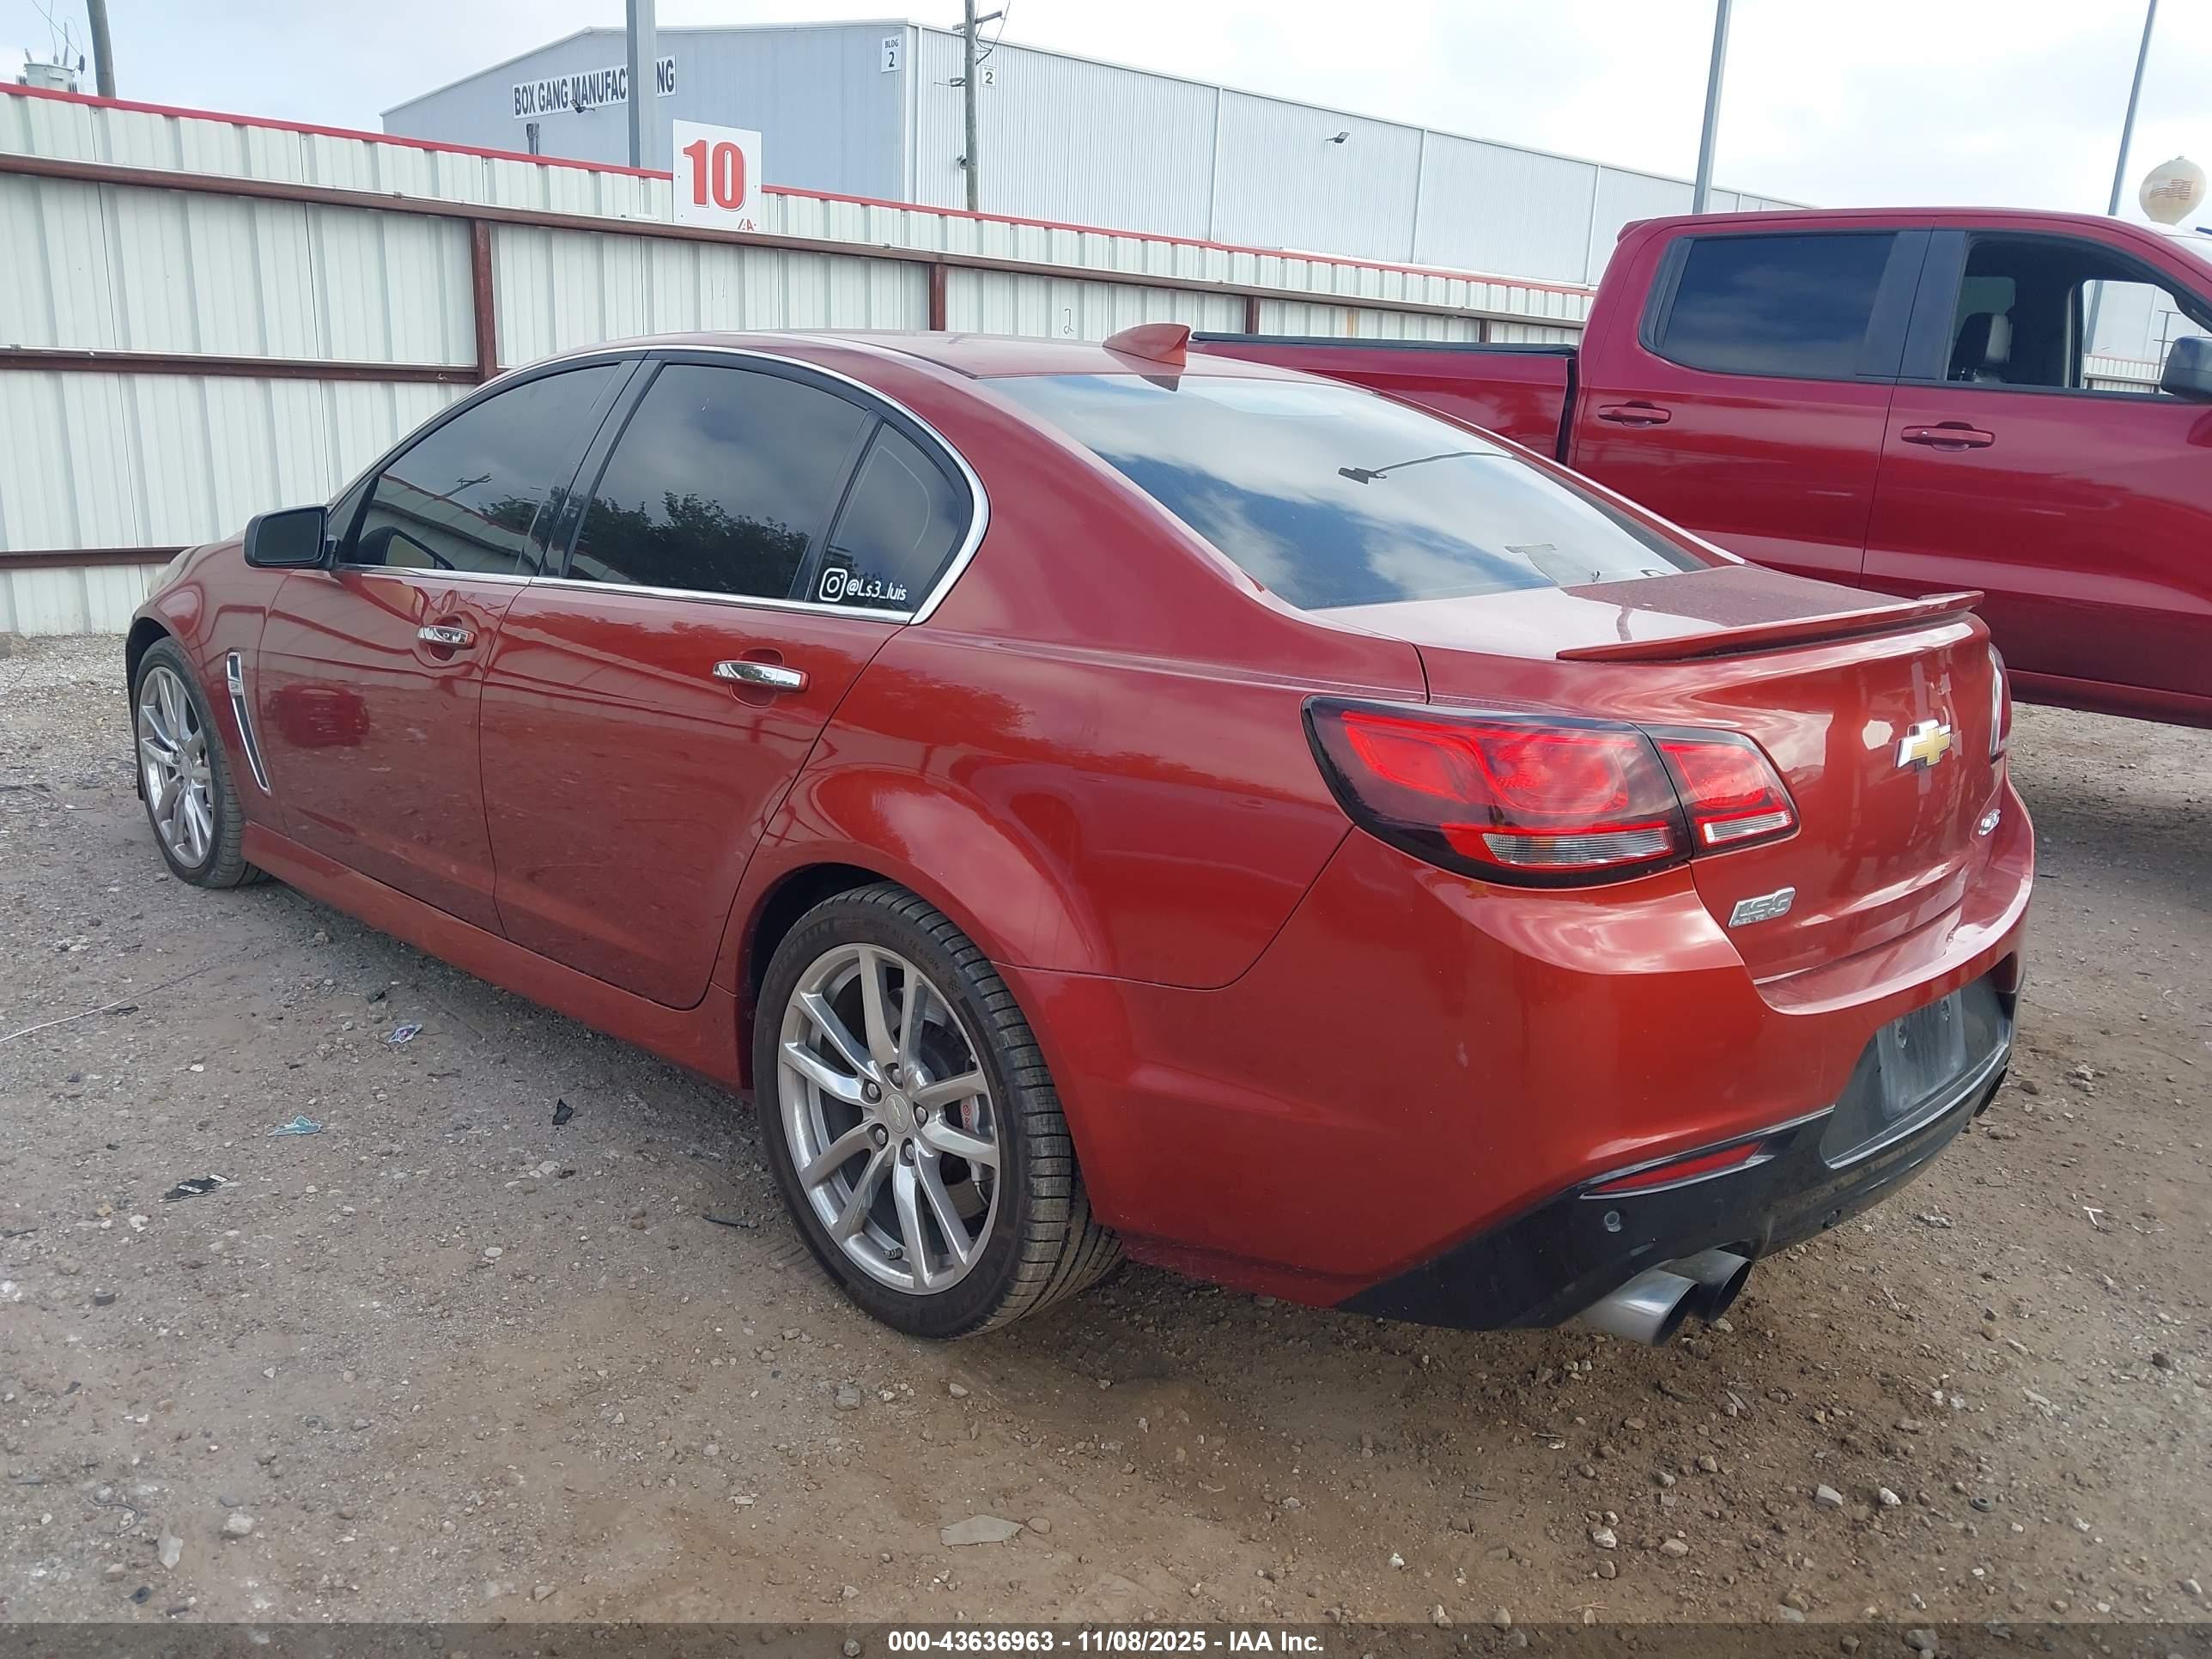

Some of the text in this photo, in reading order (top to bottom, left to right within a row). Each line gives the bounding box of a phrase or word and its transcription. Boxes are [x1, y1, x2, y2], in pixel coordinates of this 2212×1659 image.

[888, 51, 896, 68] 2
[984, 71, 994, 85] 2
[514, 86, 537, 116] BOX
[538, 78, 568, 112] GANG
[683, 138, 747, 212] 10
